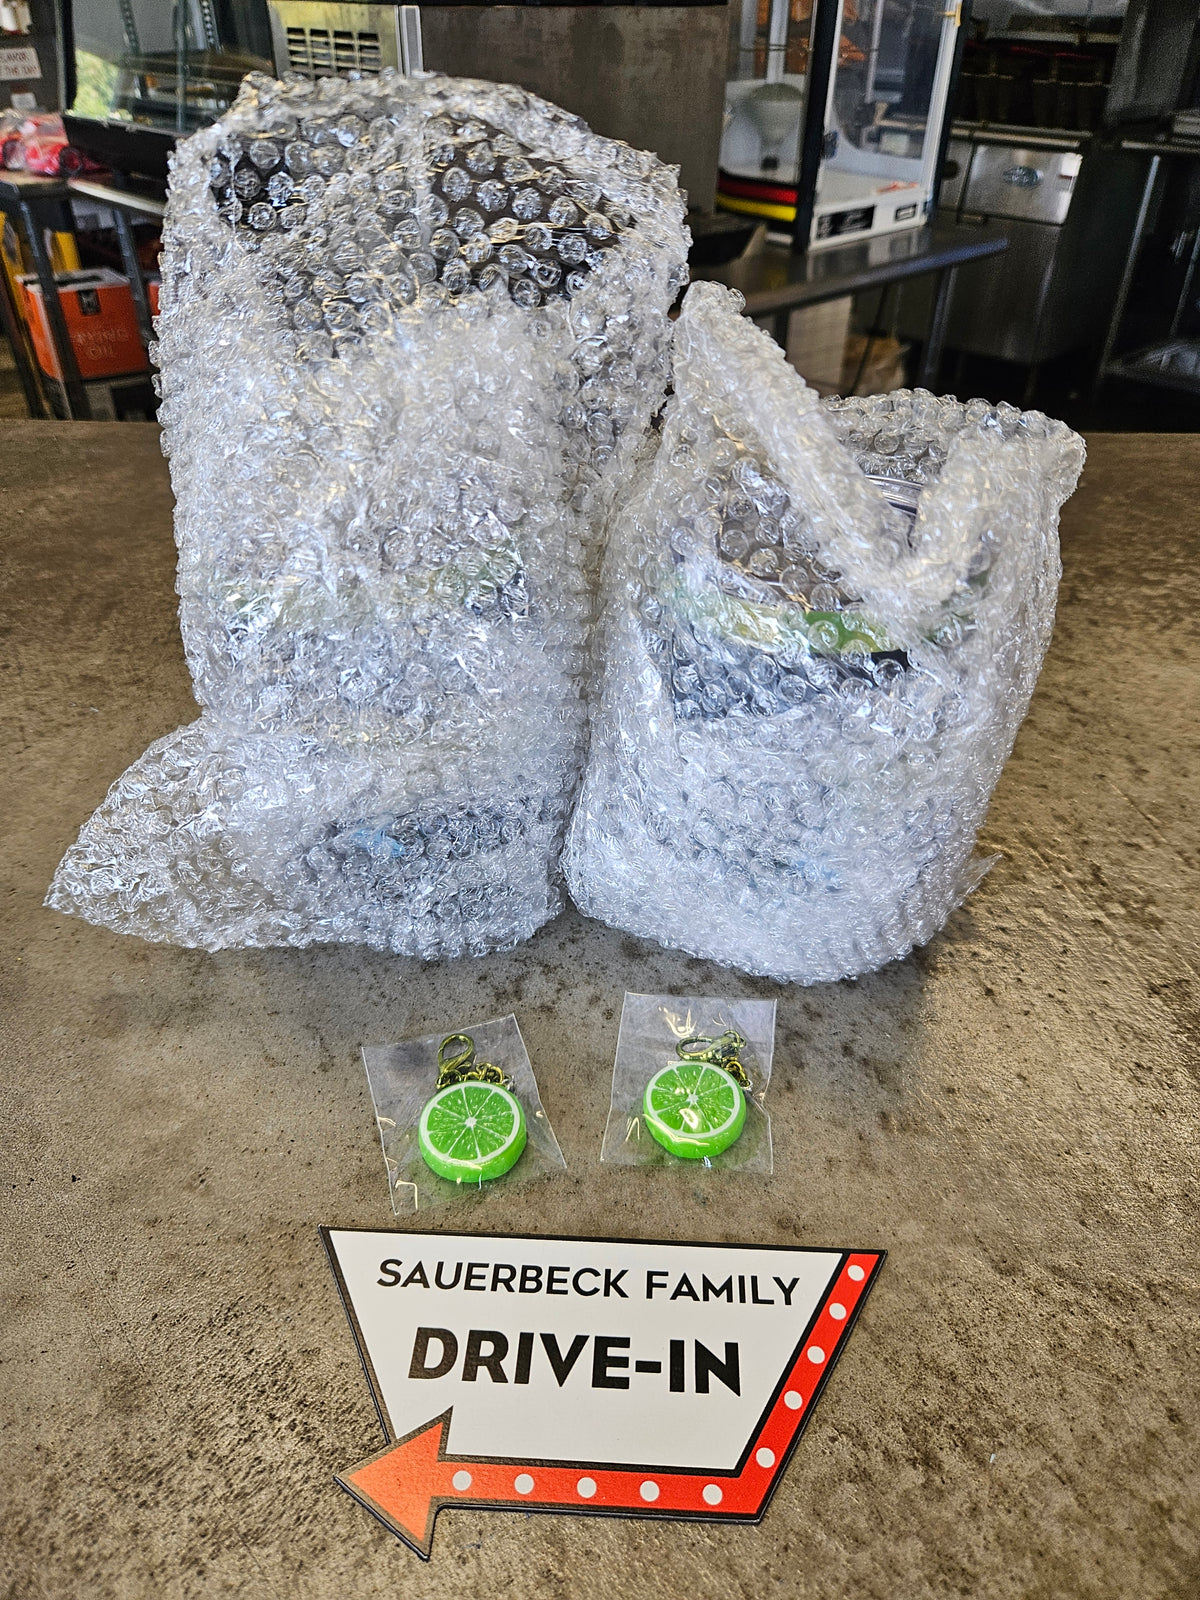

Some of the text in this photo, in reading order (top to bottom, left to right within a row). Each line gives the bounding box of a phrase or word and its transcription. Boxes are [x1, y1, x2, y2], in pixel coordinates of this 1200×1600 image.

[377, 1258, 800, 1306] SAUERBECK FAMILY
[407, 1326, 741, 1397] DRIVE-IN
